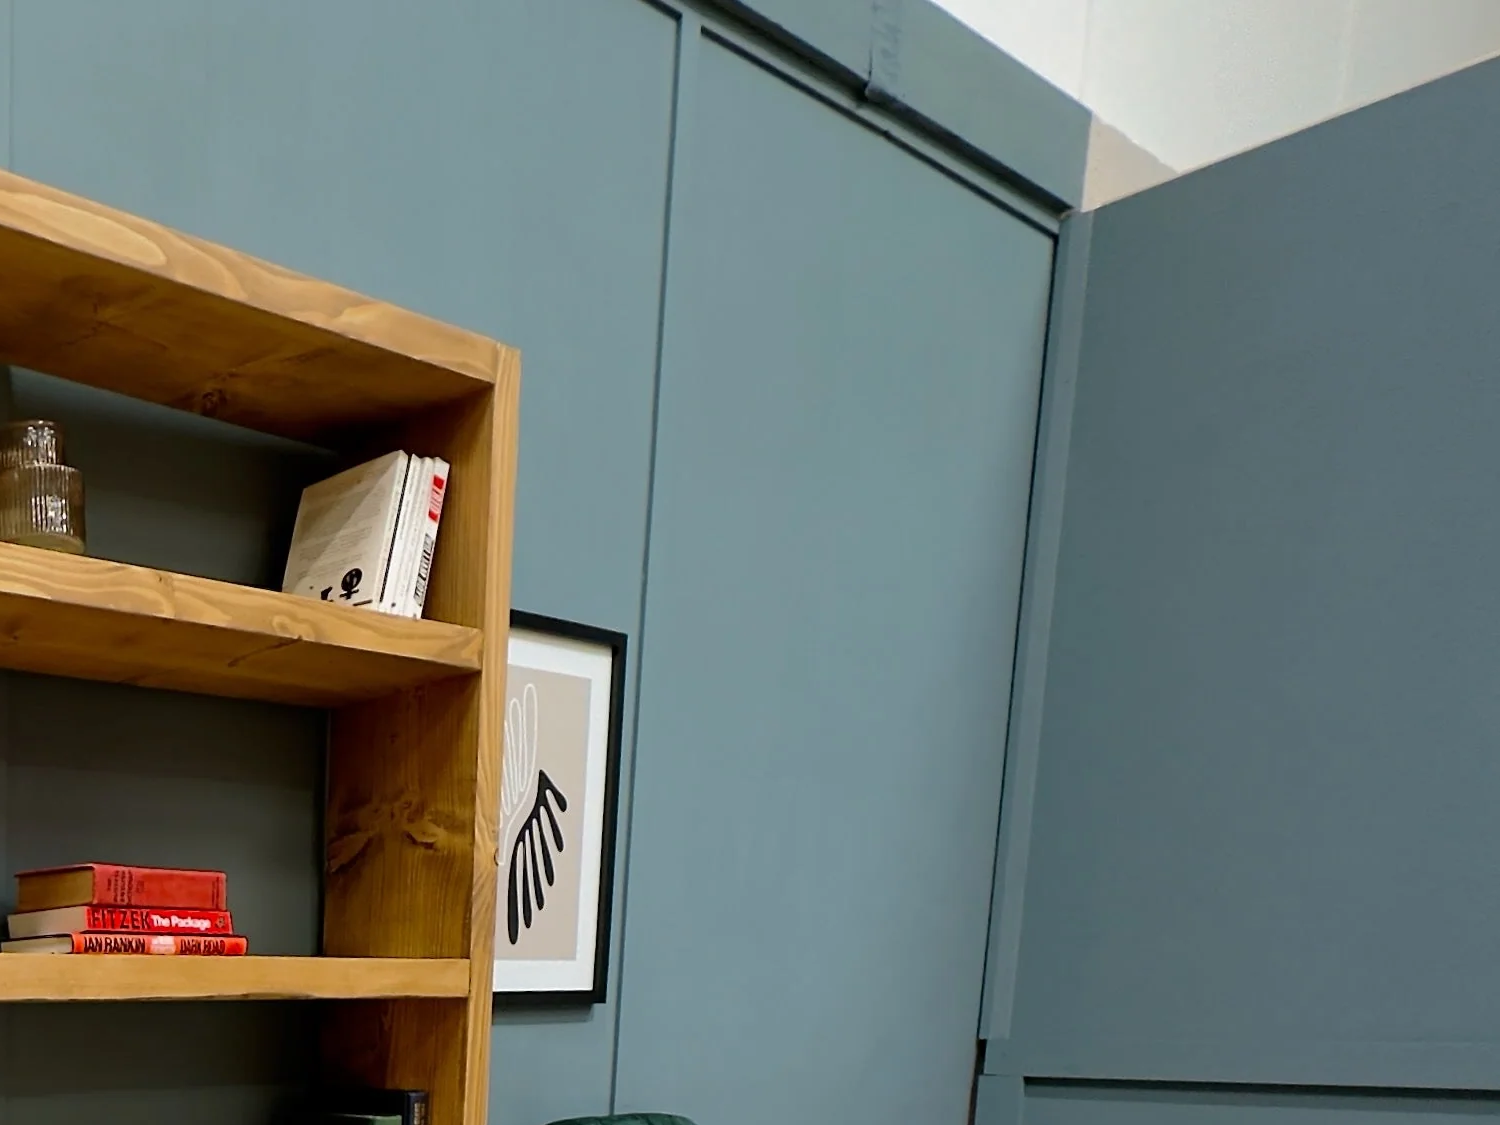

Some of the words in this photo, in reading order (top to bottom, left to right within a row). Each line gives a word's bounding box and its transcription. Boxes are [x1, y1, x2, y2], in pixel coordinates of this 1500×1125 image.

[92, 907, 150, 931] FITZEK
[150, 914, 170, 928] The
[171, 915, 211, 931] Package
[84, 936, 103, 953] IAN
[104, 936, 146, 954] RANKIN
